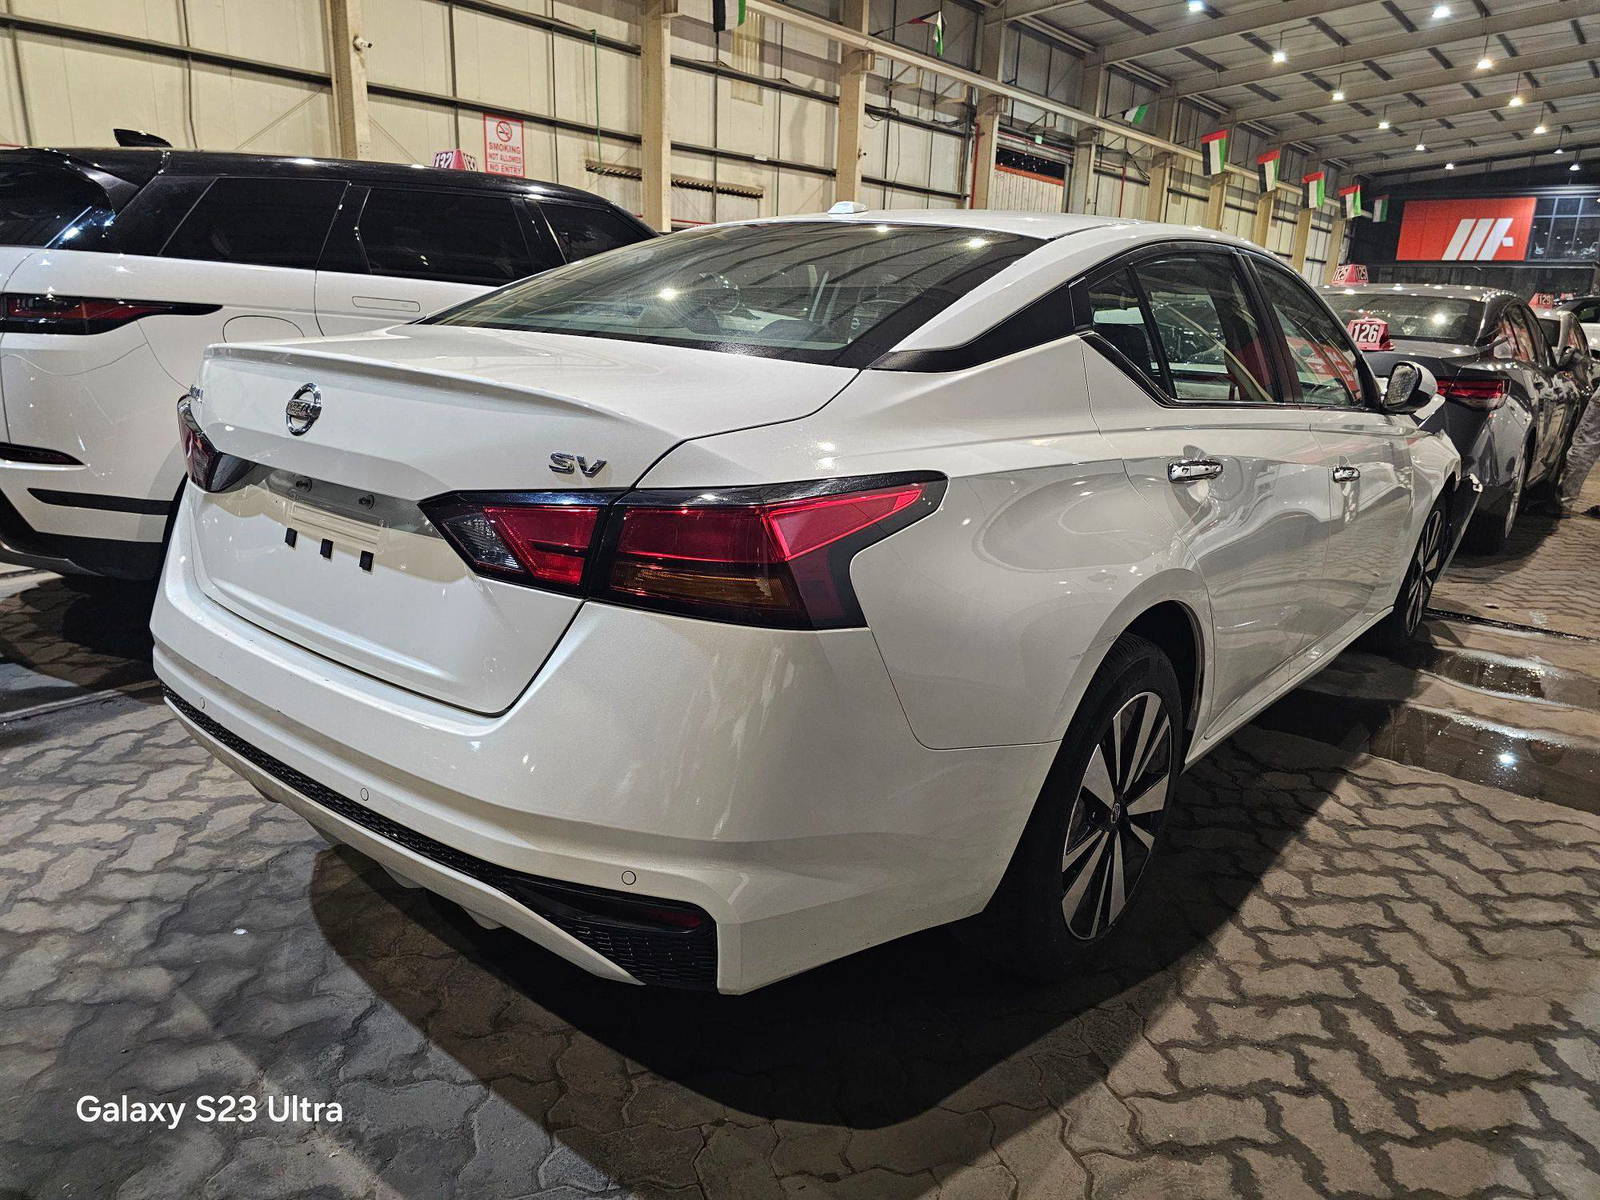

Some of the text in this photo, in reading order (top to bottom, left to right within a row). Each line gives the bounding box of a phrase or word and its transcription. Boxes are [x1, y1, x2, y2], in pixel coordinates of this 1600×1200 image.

[489, 142, 521, 154] SMOKING
[1354, 323, 1380, 342] 126
[549, 452, 607, 478] SV
